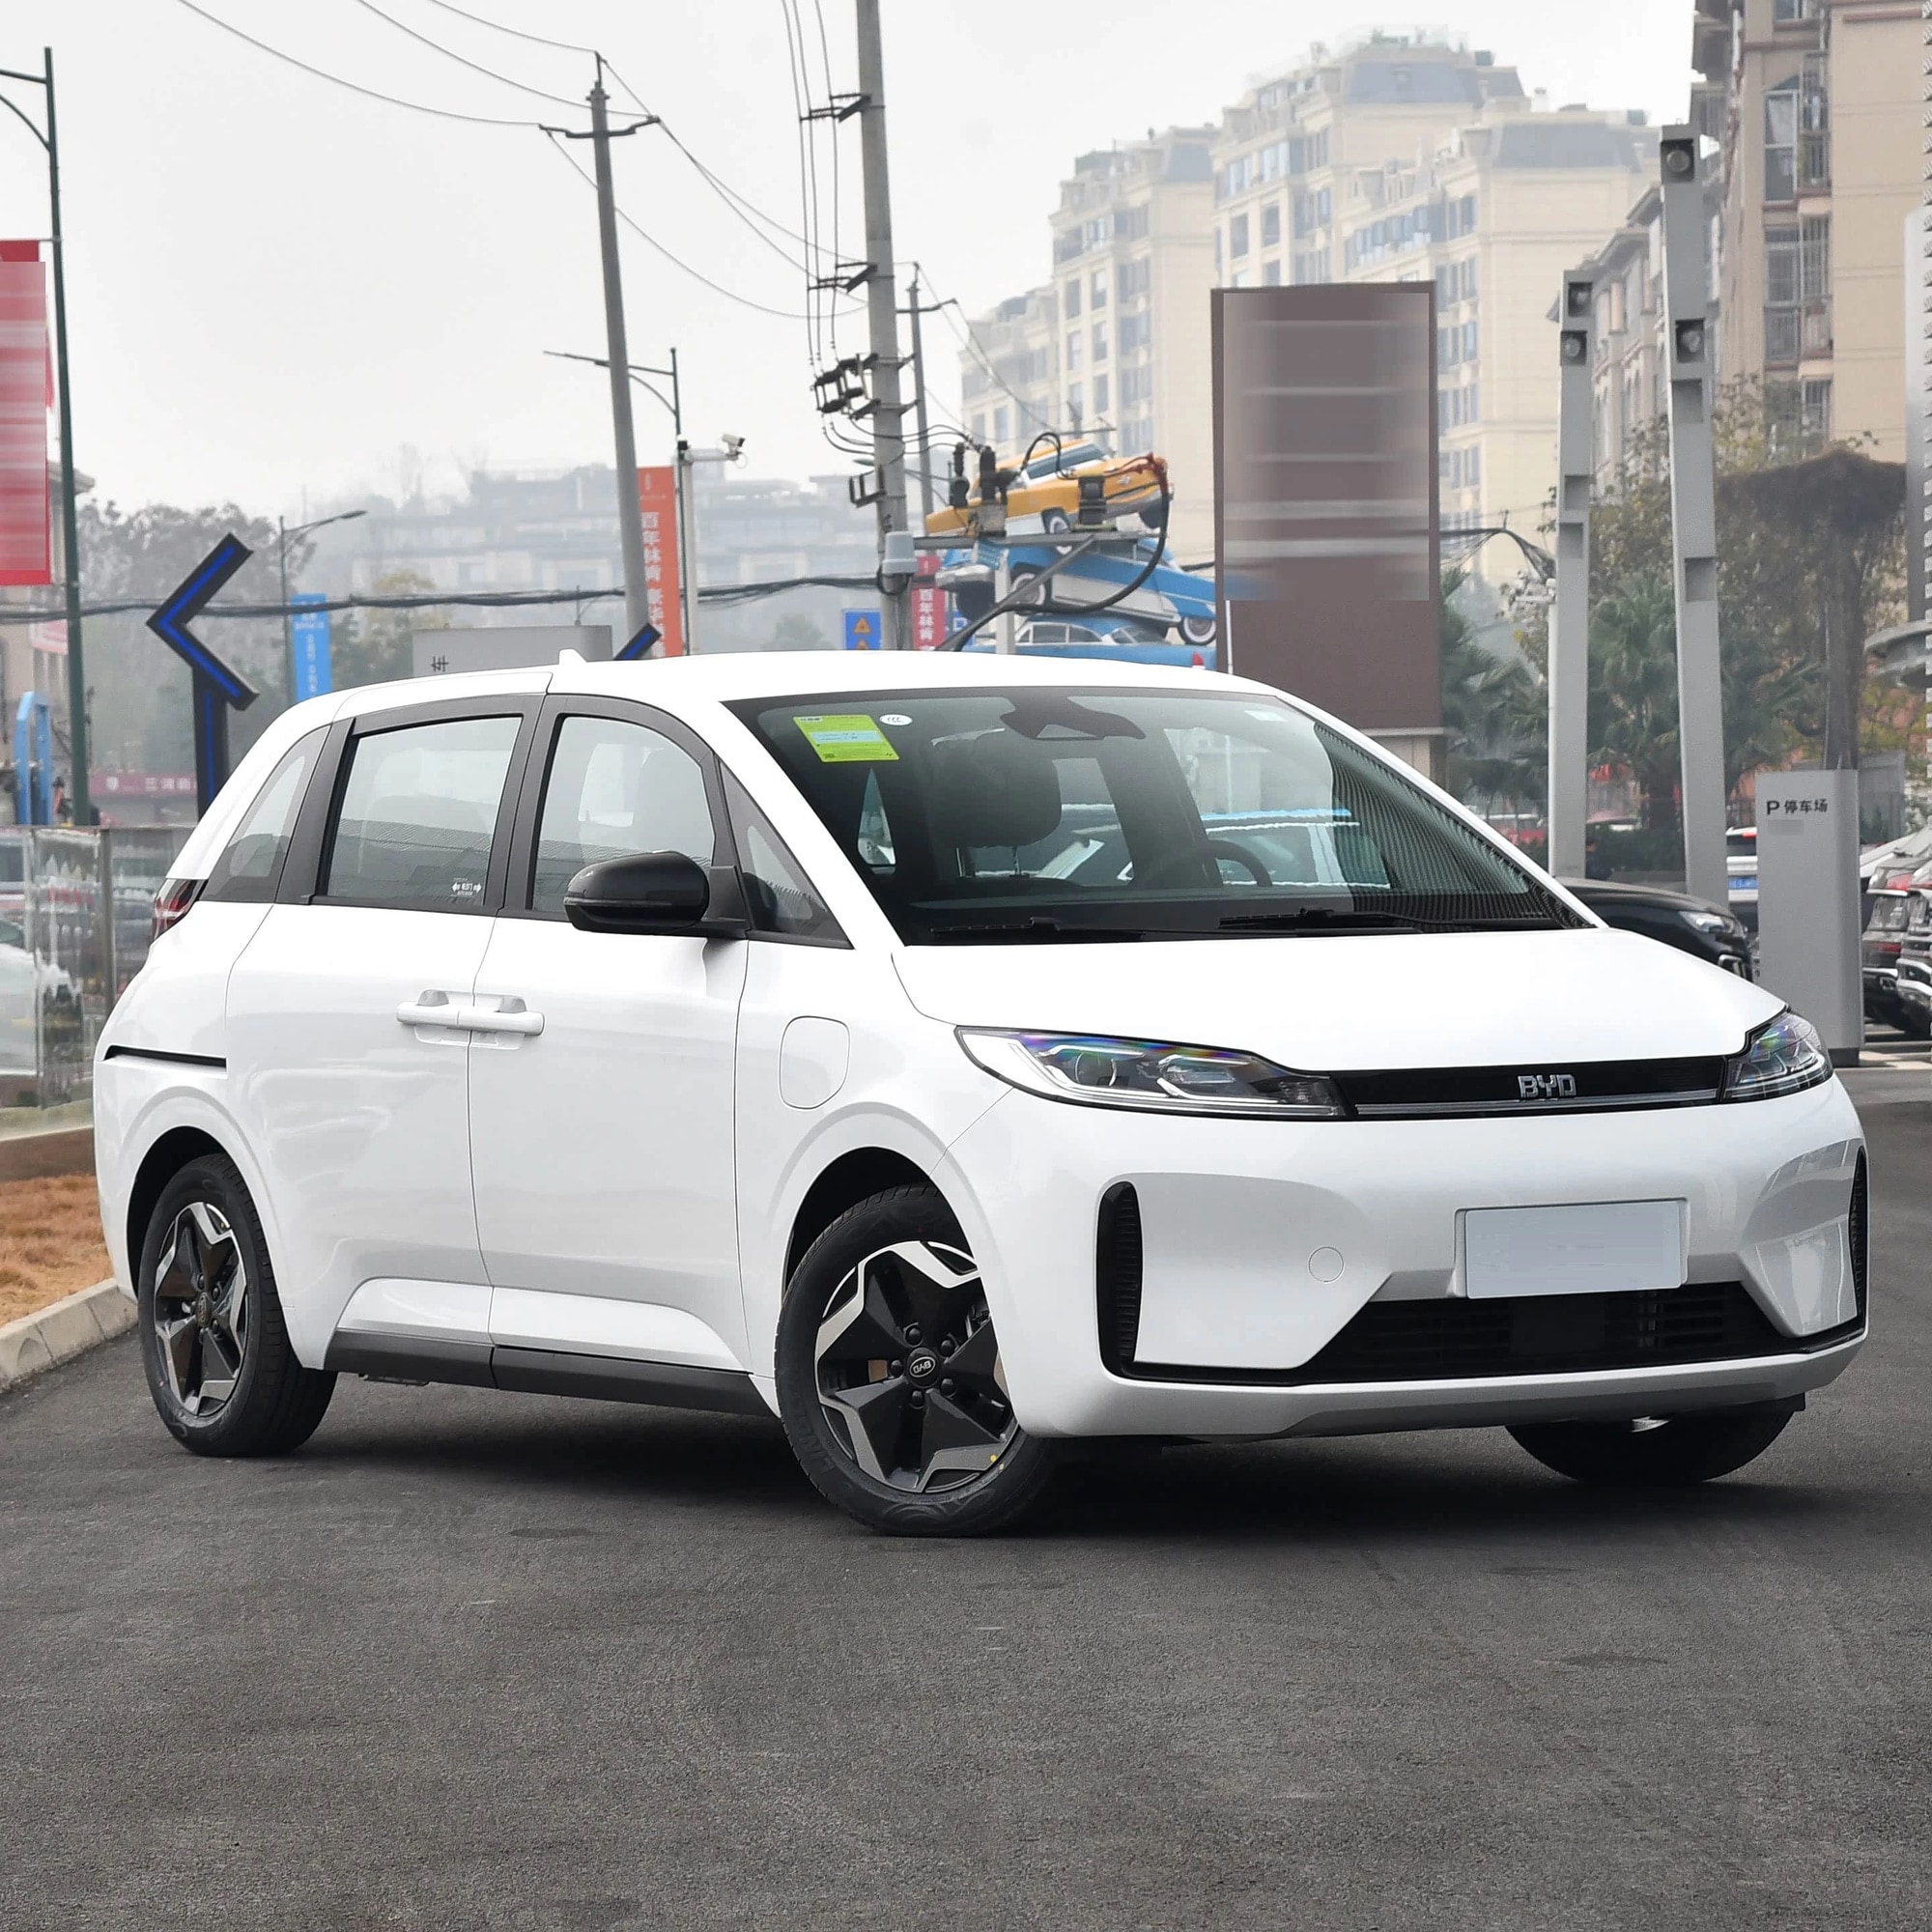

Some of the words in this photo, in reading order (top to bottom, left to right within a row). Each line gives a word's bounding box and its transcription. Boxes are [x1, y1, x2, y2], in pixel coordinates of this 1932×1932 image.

[1767, 800, 1780, 815] P
[1784, 798, 1829, 813] 停车场
[1518, 1074, 1577, 1098] BYD
[913, 1360, 932, 1374] BYD
